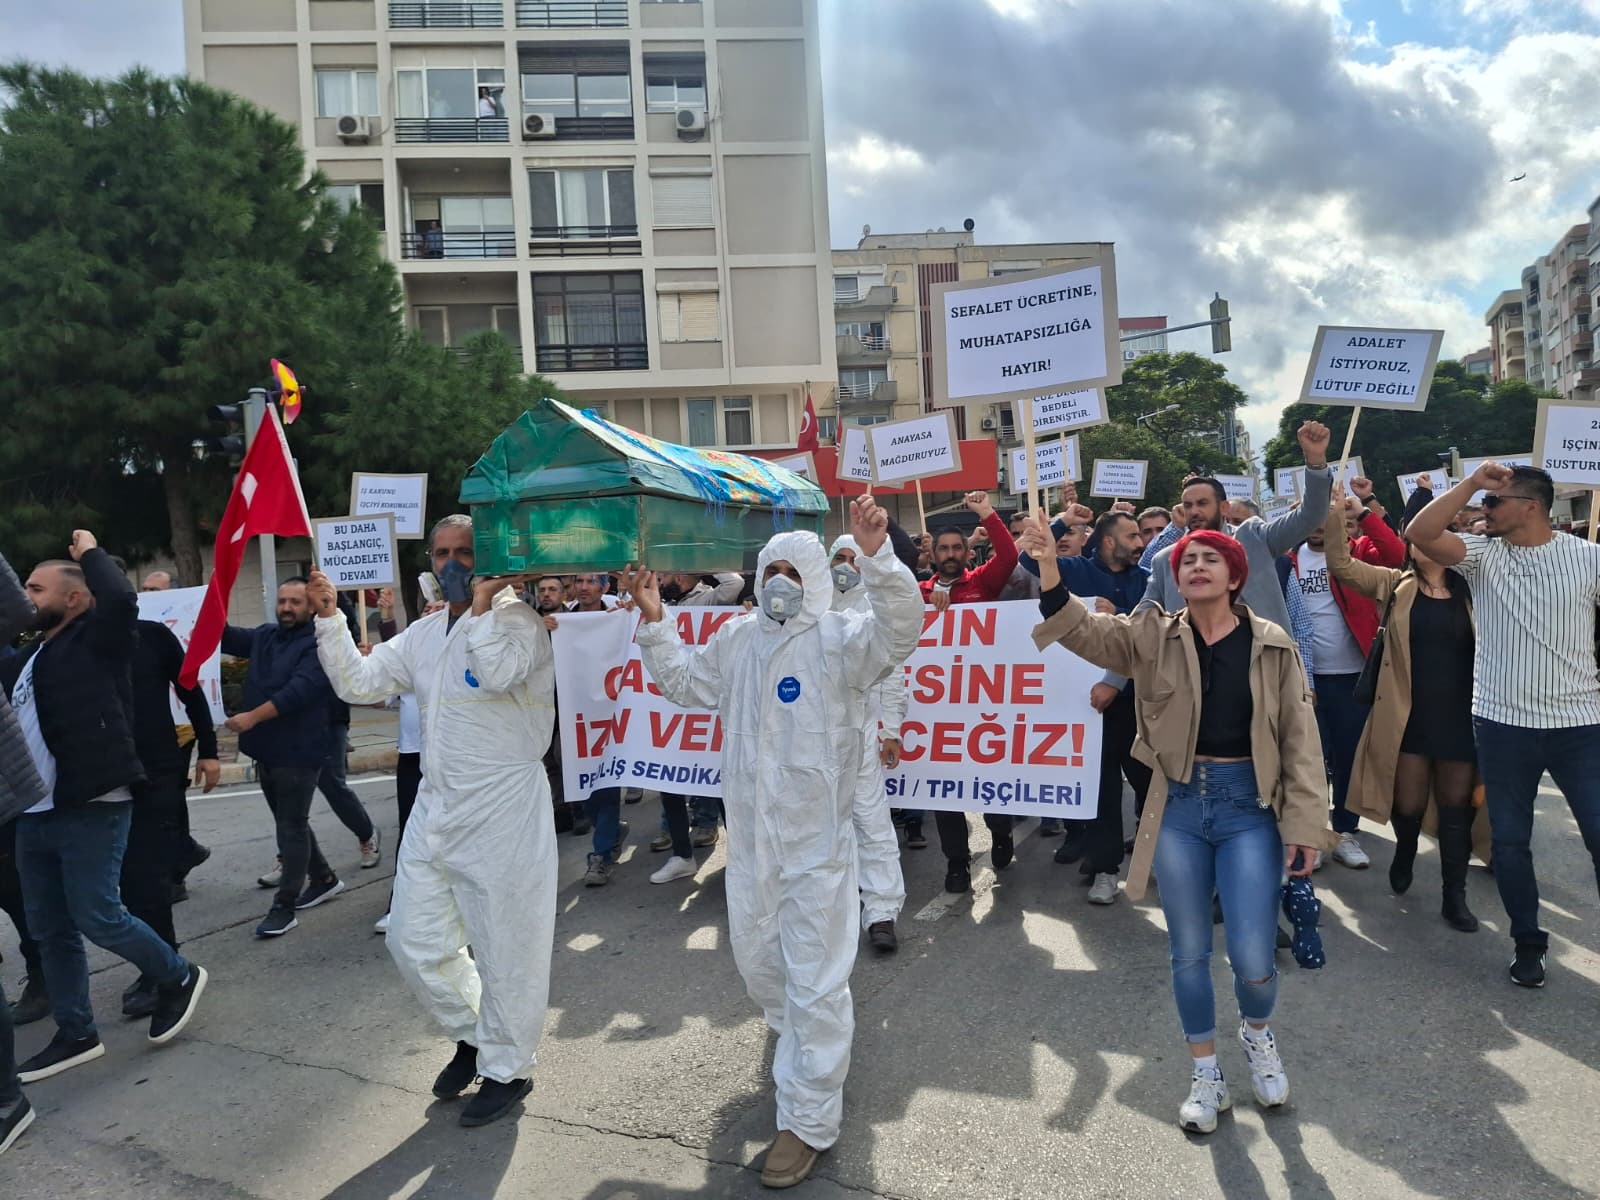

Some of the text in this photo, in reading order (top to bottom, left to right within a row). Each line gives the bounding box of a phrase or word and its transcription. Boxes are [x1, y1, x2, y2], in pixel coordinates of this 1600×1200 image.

[951, 284, 1097, 318] SEFALET ÜCRETİNE,
[959, 319, 1092, 349] MUHATAPSIZLIĞA
[1347, 336, 1406, 349] ADALET
[1001, 359, 1051, 377] HAYIR!
[1330, 356, 1411, 373] İSTİYORUZ,
[1315, 378, 1415, 396] LÜTUF DEĞİL!
[890, 431, 933, 446] ANAYASA
[1562, 437, 1600, 452] İŞÇİN
[1545, 459, 1600, 471] SUSTUR
[334, 523, 377, 535] BU DAHA
[327, 538, 384, 552] BAŞLANGIÇ,
[323, 553, 390, 567] MÜCADELEYE
[339, 569, 378, 581] DEVAM!
[1307, 568, 1327, 577] THE
[1298, 576, 1328, 587] ORTH
[1301, 584, 1329, 595] FACE
[926, 780, 964, 800] TPI
[973, 776, 1082, 807] İŞÇİLERİ
